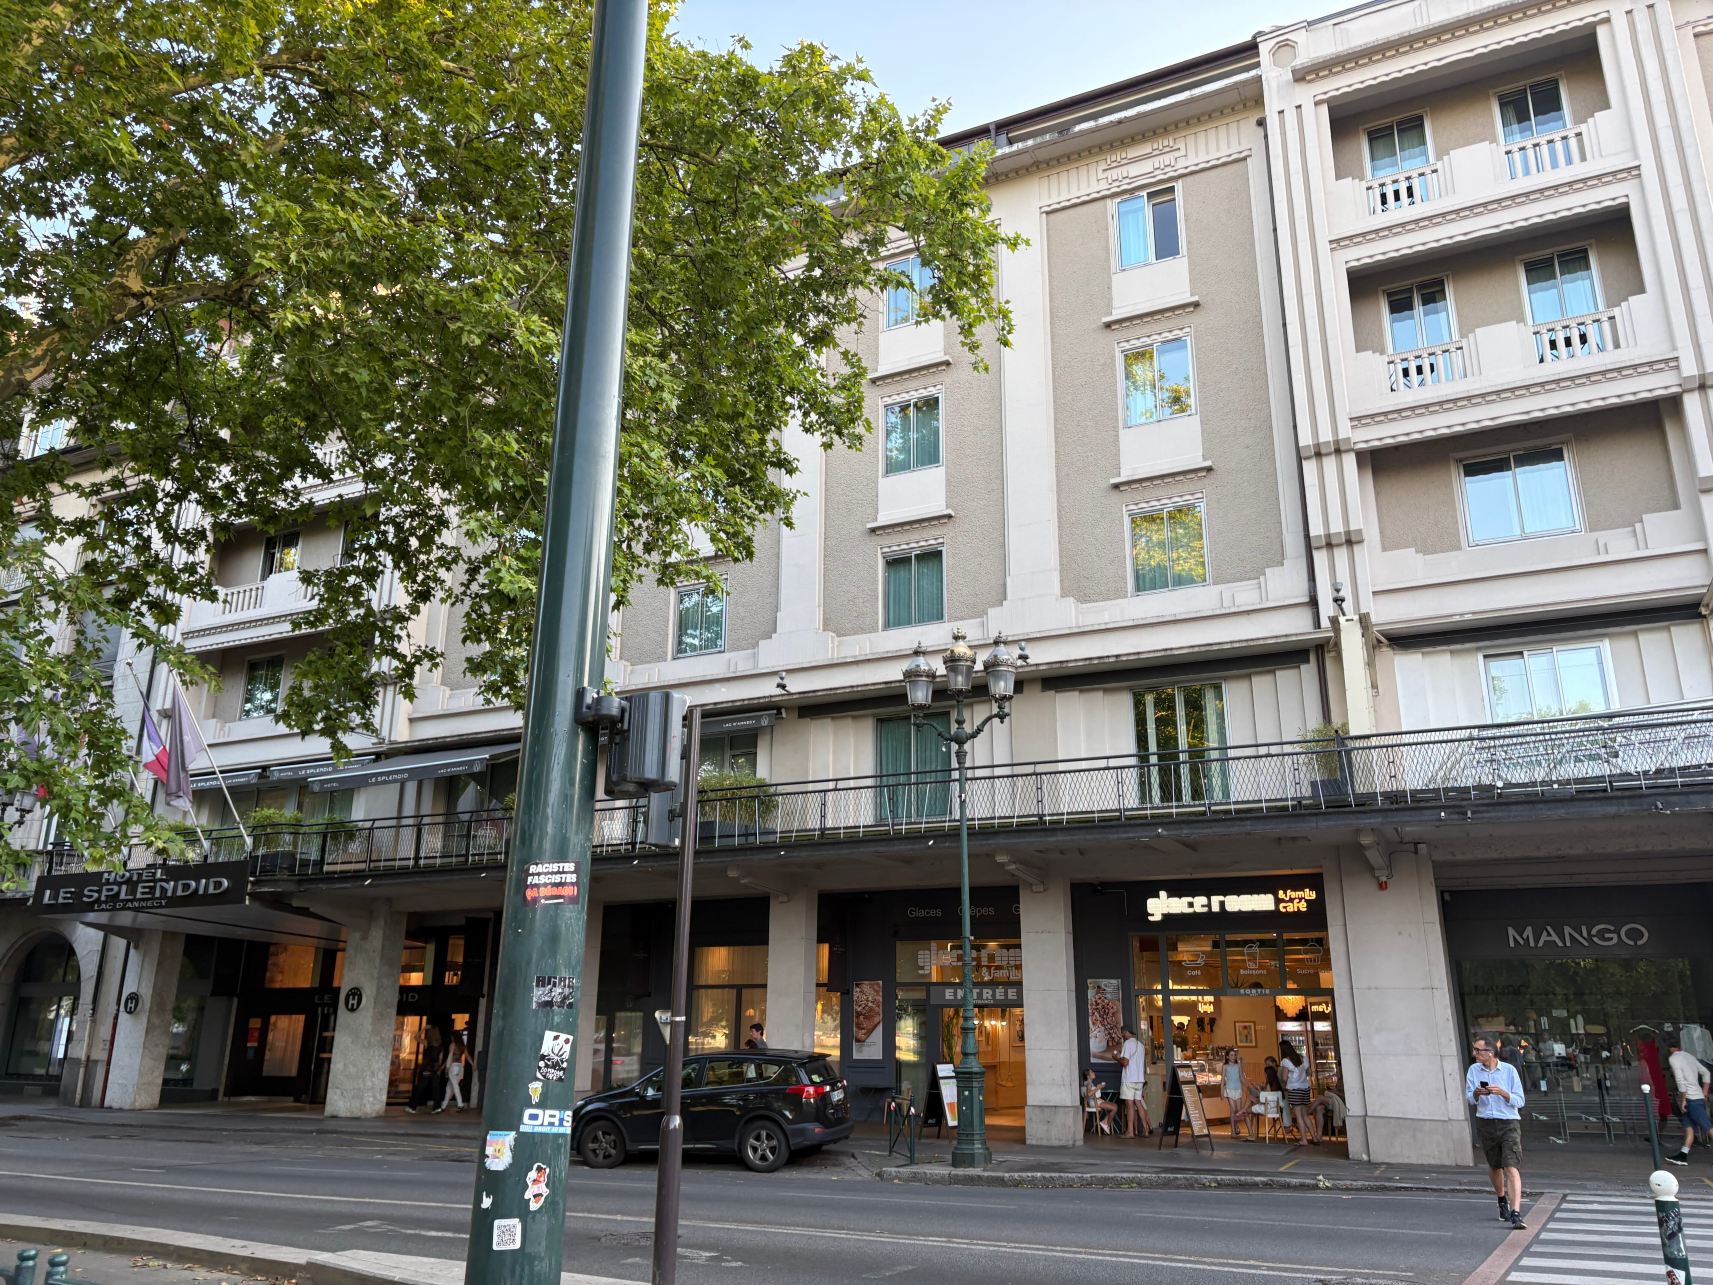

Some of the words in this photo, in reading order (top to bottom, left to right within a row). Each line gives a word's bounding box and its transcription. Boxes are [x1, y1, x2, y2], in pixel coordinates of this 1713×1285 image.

[377, 773, 409, 782] SPLENDID
[529, 862, 576, 873] RACISTES
[102, 868, 167, 883] HOTEL
[526, 873, 577, 884] FASCISTES
[42, 887, 76, 905] LE
[82, 877, 231, 902] SPLENDID
[94, 902, 114, 910] LAC
[116, 899, 167, 909] D'ANNECY
[1146, 890, 1208, 922] glace
[1210, 893, 1275, 913] room
[1279, 899, 1308, 912] café
[907, 906, 942, 918] Glaces
[957, 905, 995, 918] Cêpes
[1506, 923, 1649, 948] MANGO
[945, 986, 1017, 999] ENTRÉE
